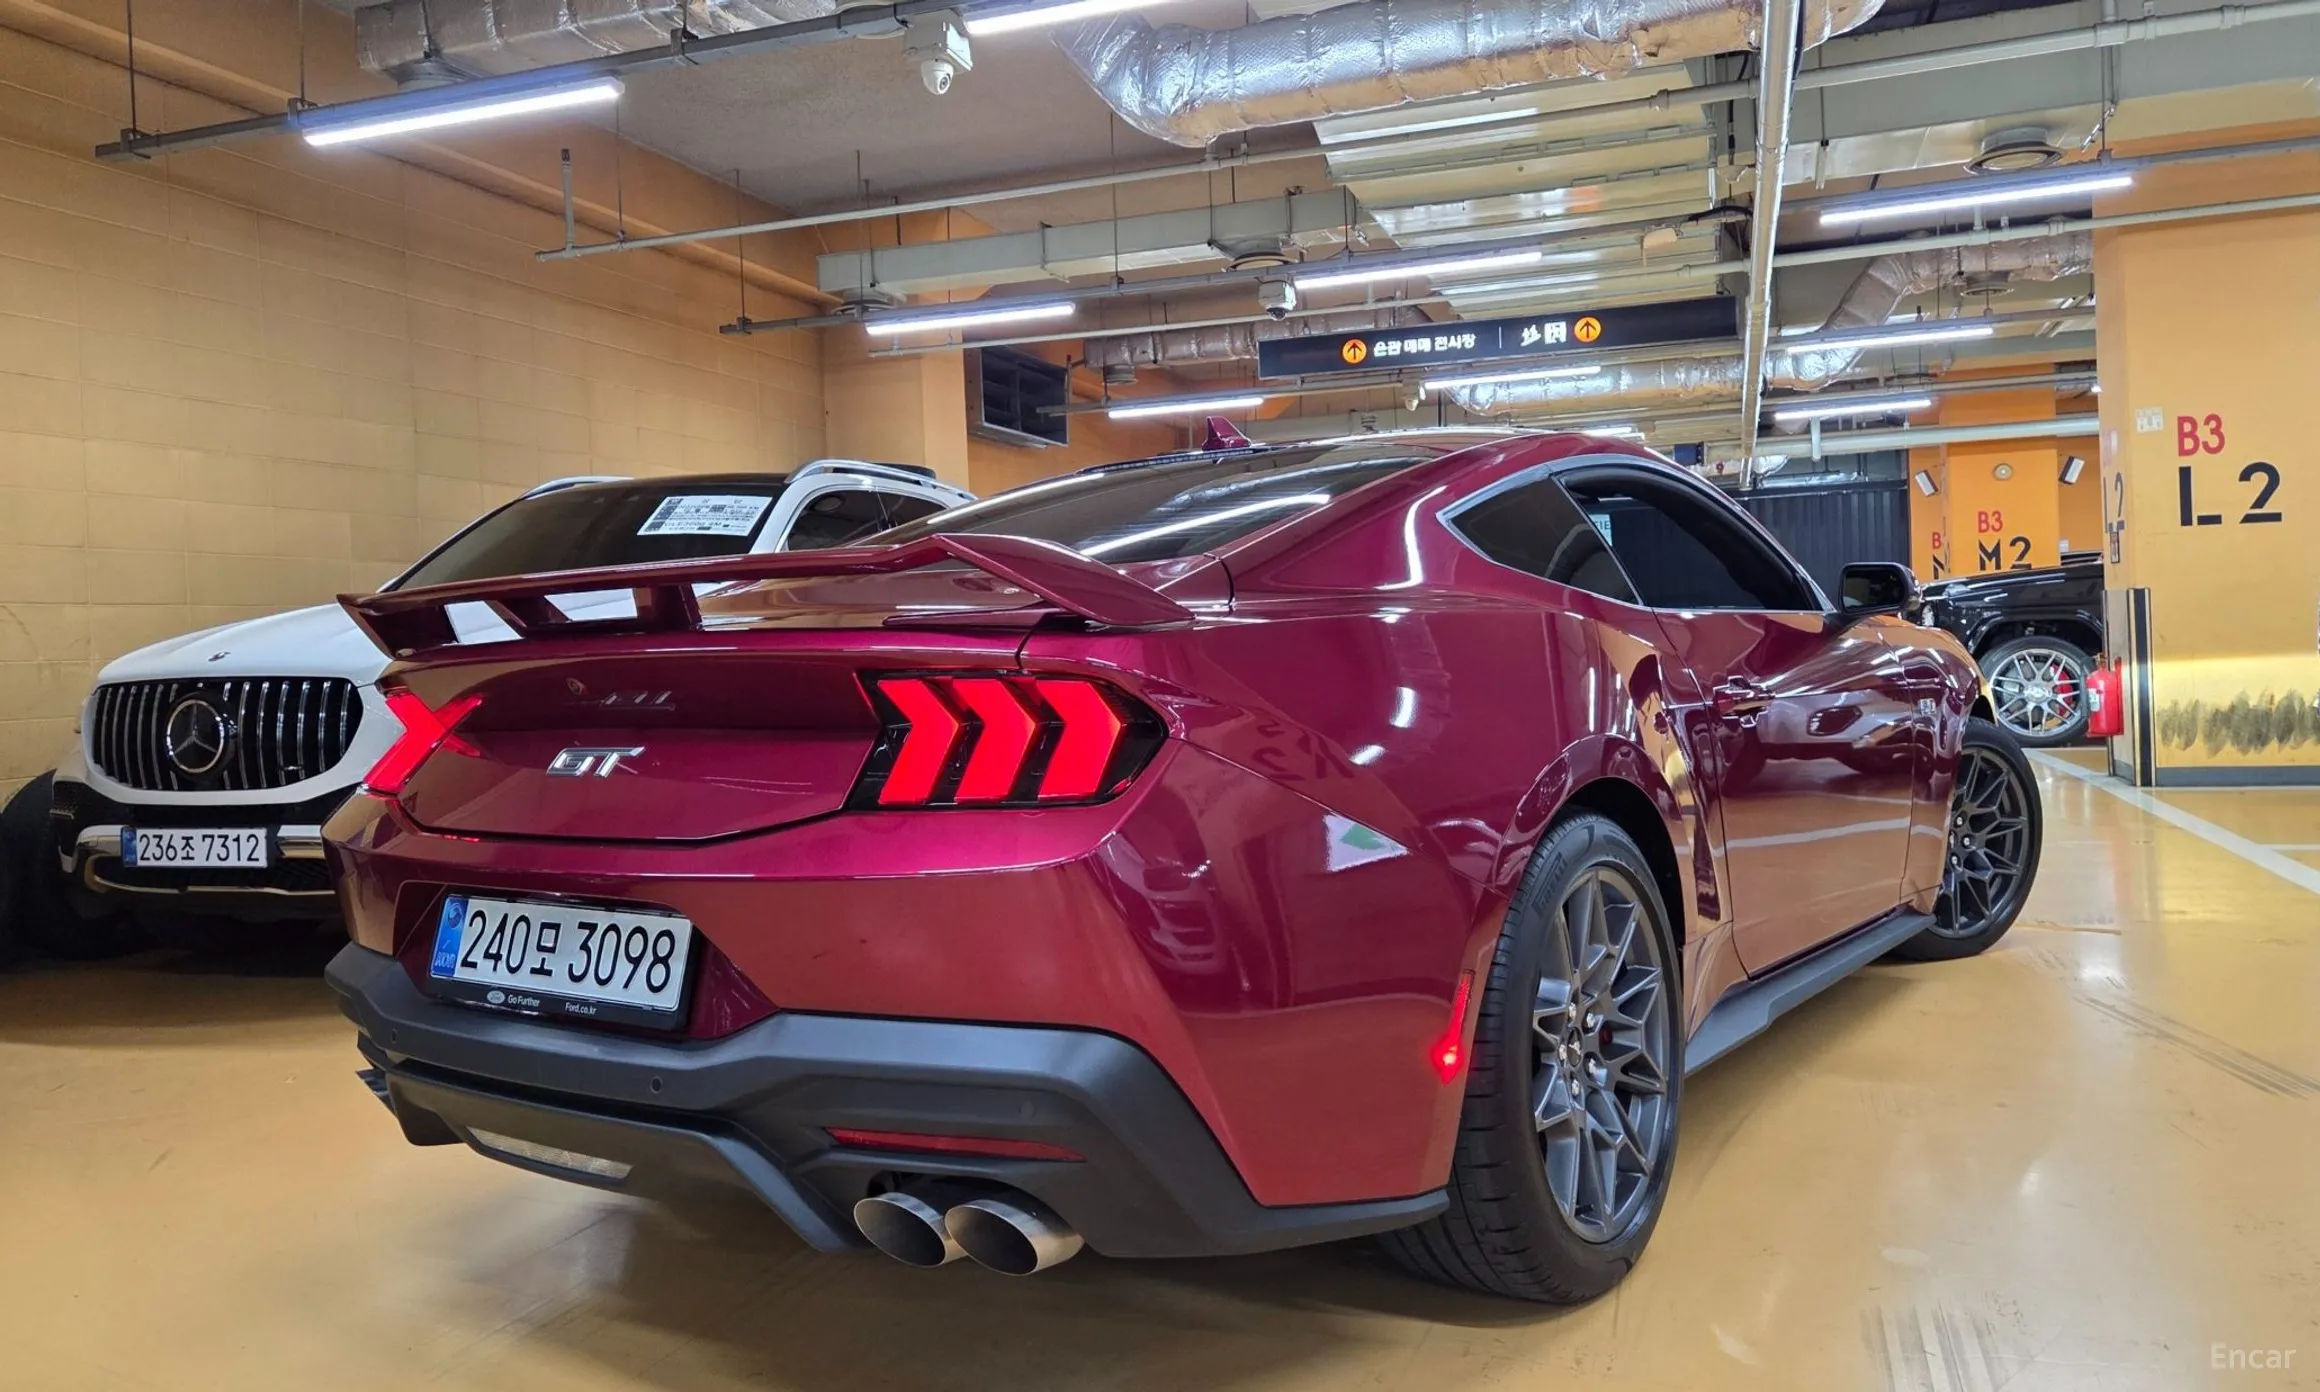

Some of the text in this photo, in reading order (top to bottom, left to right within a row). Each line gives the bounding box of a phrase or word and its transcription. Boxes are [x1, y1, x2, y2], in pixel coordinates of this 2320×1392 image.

[1434, 333, 1477, 351] 전시장
[2177, 413, 2226, 457] B3
[1977, 510, 2003, 533] B3
[545, 746, 645, 778] GT
[139, 834, 195, 861] 236조
[202, 834, 260, 862] 7312
[460, 909, 676, 993] 240모 3098
[507, 994, 517, 1004] Go
[517, 995, 540, 1007] Further
[565, 1002, 597, 1015] Ford.co.kr
